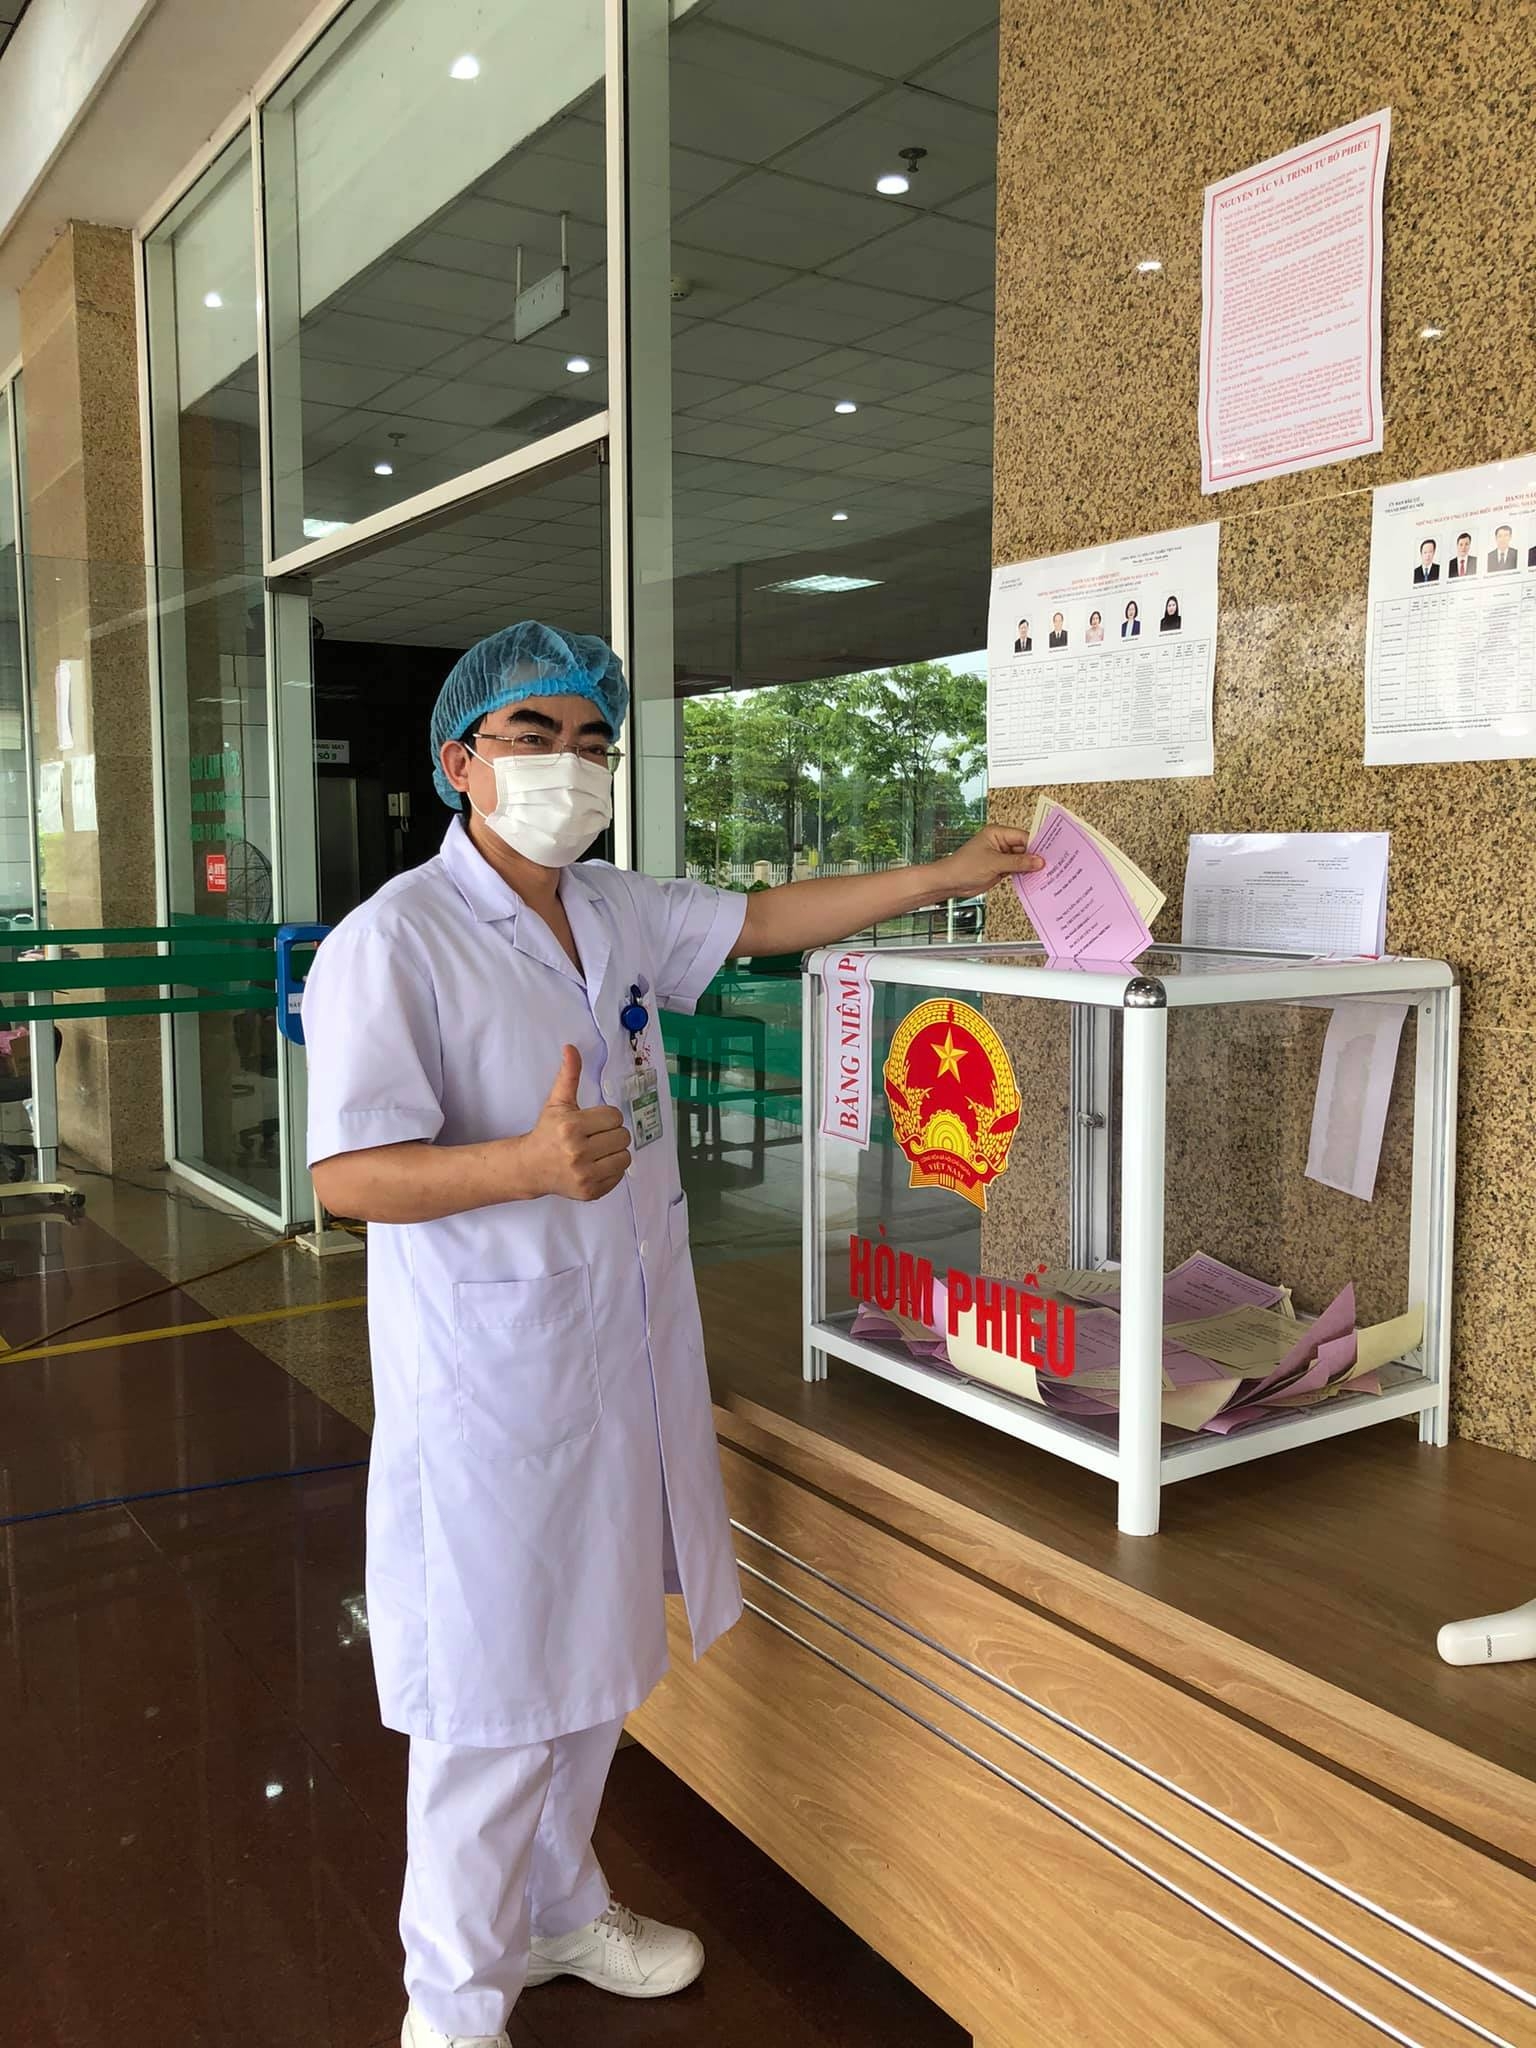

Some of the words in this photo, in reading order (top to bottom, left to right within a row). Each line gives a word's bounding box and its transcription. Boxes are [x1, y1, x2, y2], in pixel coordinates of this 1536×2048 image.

[1219, 190, 1254, 210] NGUYÊN
[1255, 181, 1272, 197] TẮC
[1274, 177, 1284, 188] VÀ
[1287, 163, 1313, 183] TRÌNH
[1342, 139, 1370, 159] PHIẾU
[836, 979, 861, 1049] NIÊM
[834, 1055, 860, 1130] BĂNG
[850, 1223, 934, 1327] HÒM
[947, 1263, 1077, 1379] PHIẾU
